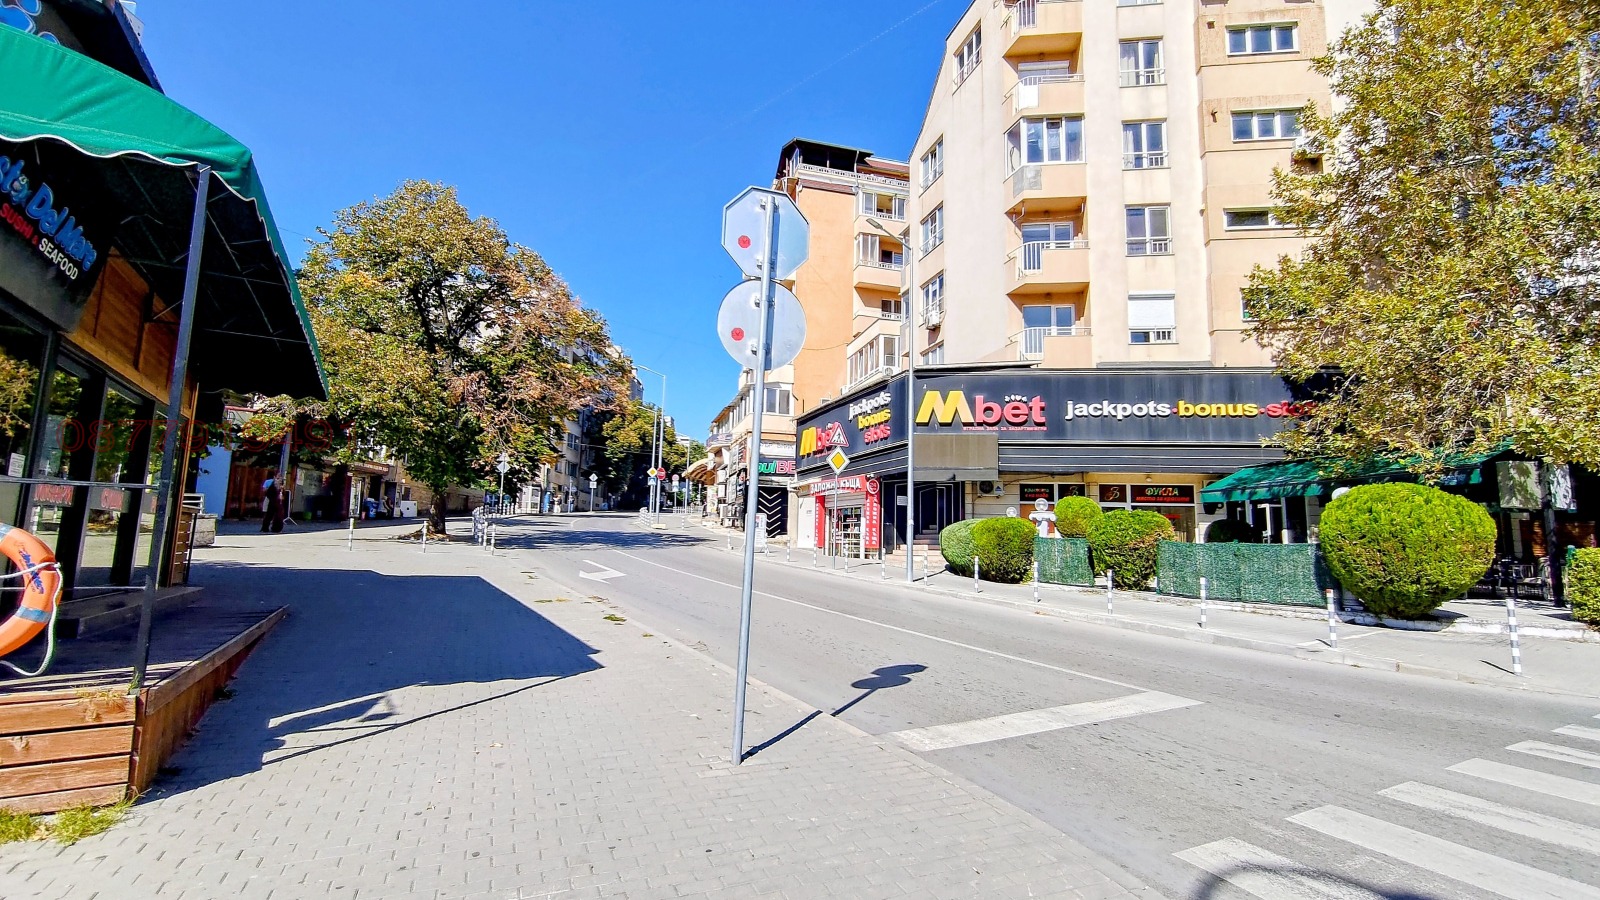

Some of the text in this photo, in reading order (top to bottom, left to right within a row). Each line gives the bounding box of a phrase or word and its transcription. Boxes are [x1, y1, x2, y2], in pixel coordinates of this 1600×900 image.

[26, 182, 69, 237] Del
[55, 216, 97, 271] Mare
[0, 203, 33, 238] SUSHI
[39, 238, 79, 280] SEAFOOD
[849, 391, 892, 421] jackpots
[915, 390, 1046, 427] Mbet
[1065, 400, 1171, 420] jackpots
[1178, 400, 1259, 417] bonus
[858, 408, 892, 431] bonus
[864, 424, 891, 444] slots
[1145, 487, 1179, 496] ФУКЛА
